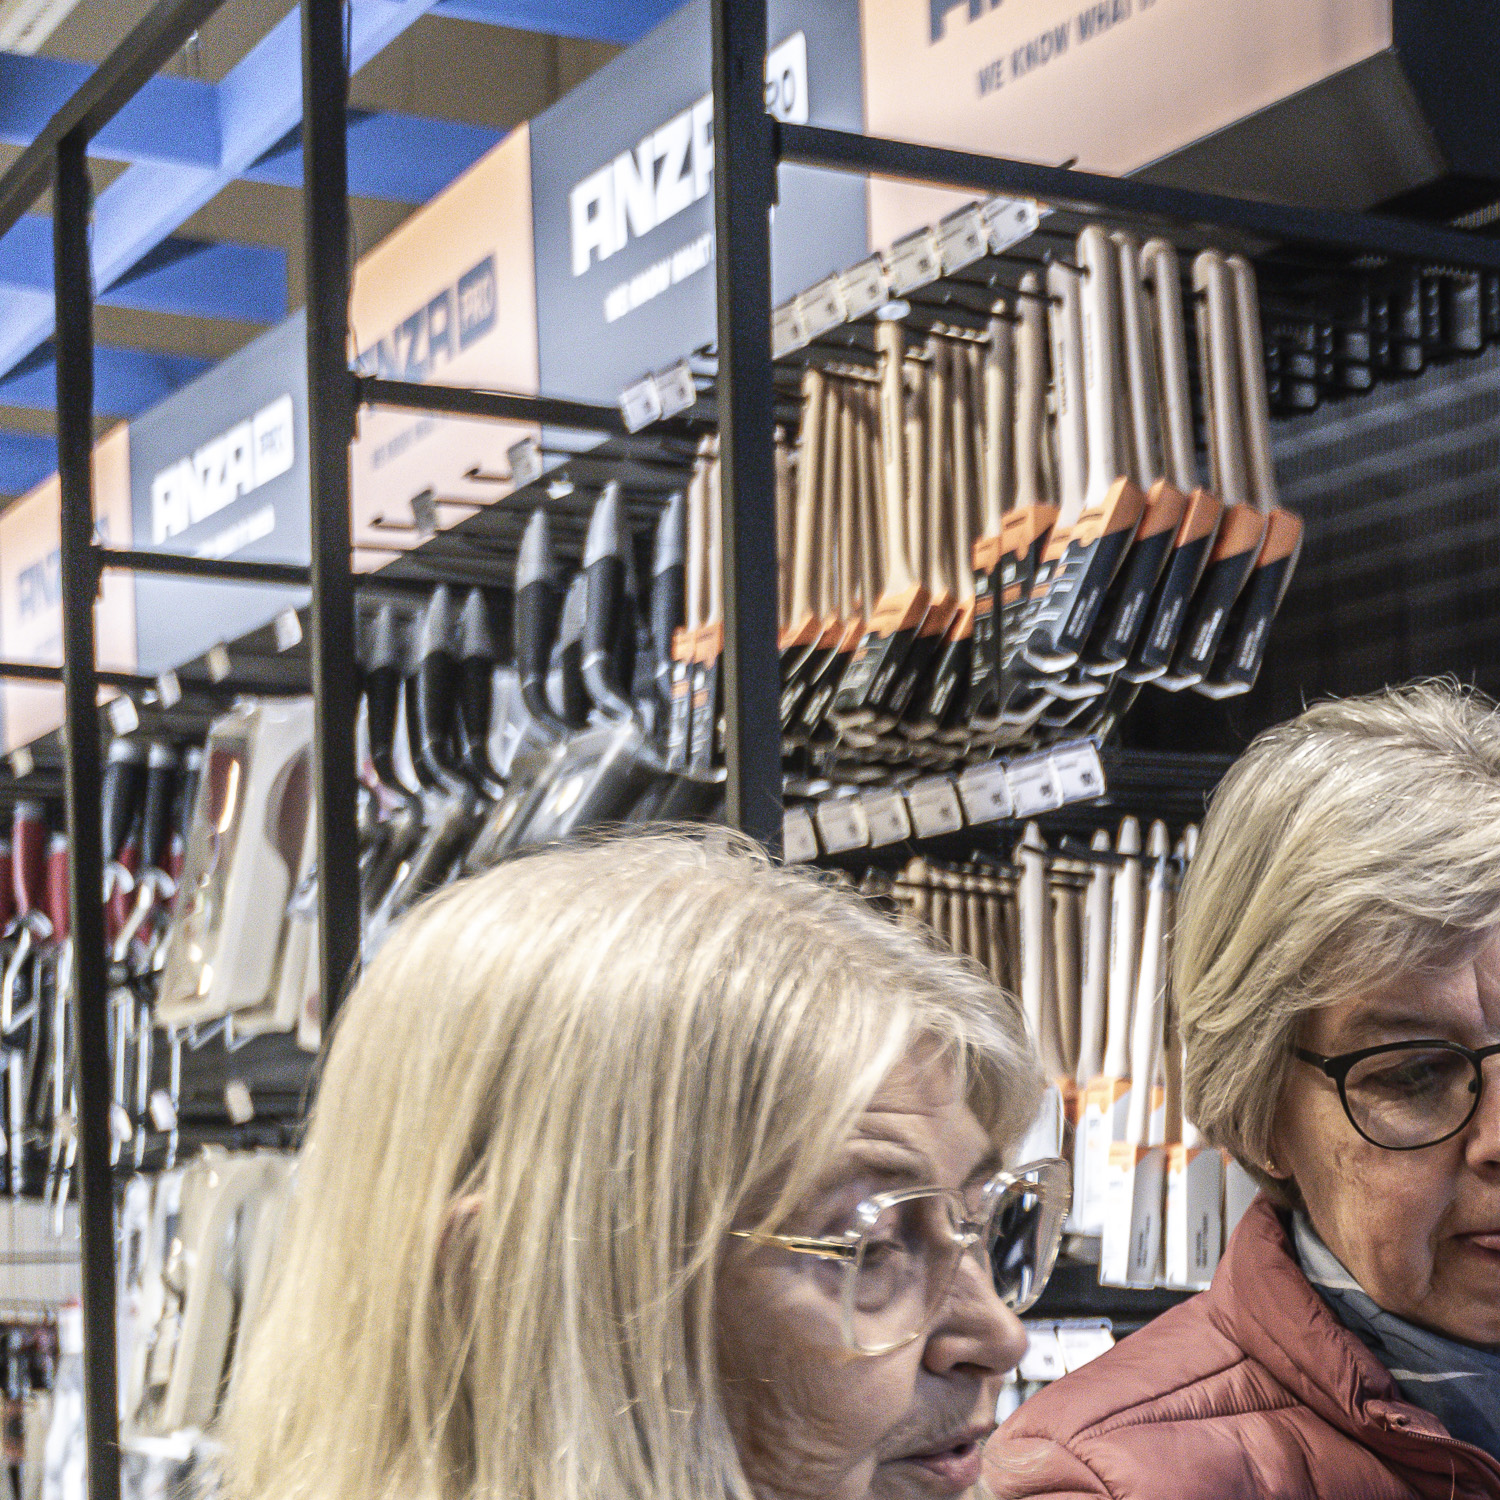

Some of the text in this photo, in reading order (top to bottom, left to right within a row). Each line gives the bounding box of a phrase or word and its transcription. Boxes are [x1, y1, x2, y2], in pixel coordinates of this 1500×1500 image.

[975, 57, 1004, 99] WE
[1010, 19, 1070, 81] KNOW
[152, 417, 250, 546] ANZA
